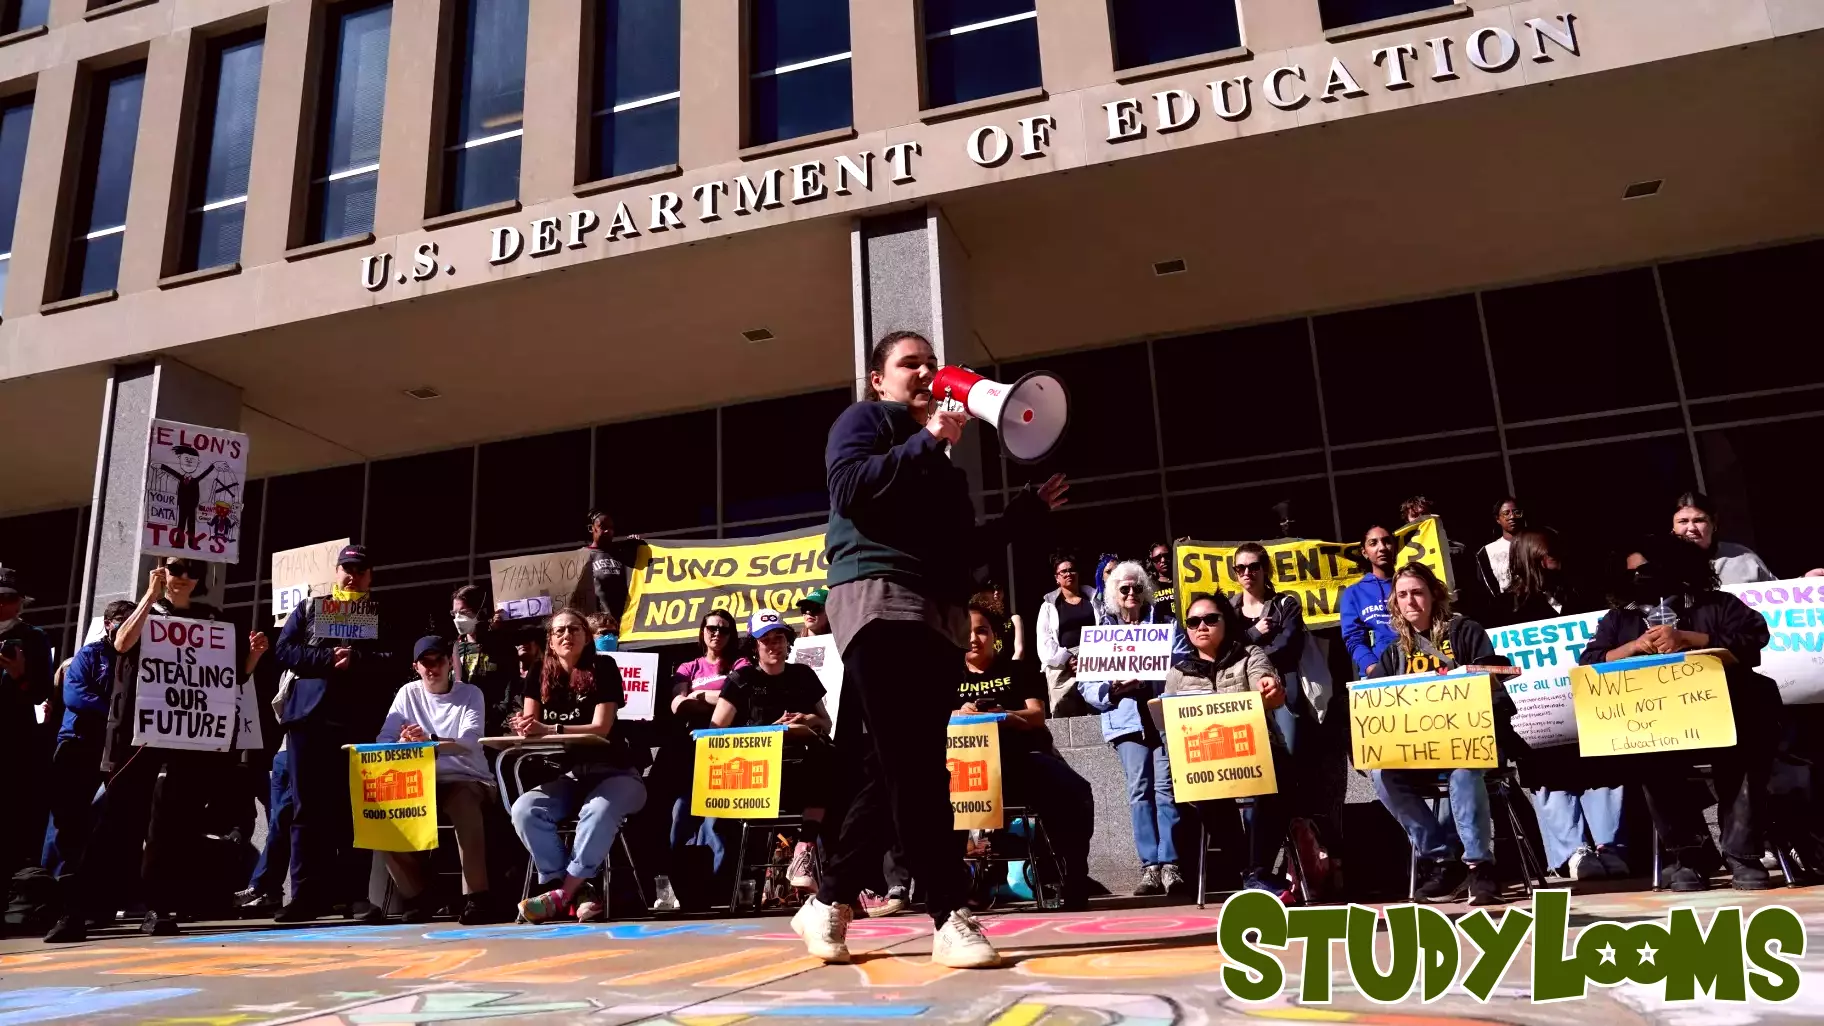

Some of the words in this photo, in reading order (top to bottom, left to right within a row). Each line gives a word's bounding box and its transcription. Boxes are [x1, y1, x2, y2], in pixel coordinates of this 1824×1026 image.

[360, 241, 456, 292] U.S.
[489, 141, 922, 266] DEPARTMENT
[966, 114, 1056, 168] OF
[1103, 13, 1580, 144] EDUCATION
[157, 426, 241, 459] ELON'S
[150, 491, 175, 505] YOUR
[151, 506, 175, 520] DATA
[147, 522, 226, 553] TOYS
[645, 554, 738, 584] FUND
[1182, 544, 1365, 583] STENTS
[498, 560, 552, 592] THANK
[280, 588, 302, 611] ED
[507, 598, 542, 619] ED
[644, 596, 705, 626] NOT
[150, 619, 225, 649] DOGE
[329, 624, 365, 638] FUTURE
[1083, 628, 1169, 643] EDUCATION
[176, 647, 197, 665] IS
[1113, 643, 1123, 652] is
[1078, 655, 1127, 673] HUMAN
[1128, 655, 1170, 673] RIGHT
[1506, 646, 1557, 669] ITH
[141, 657, 234, 688] STEALING
[957, 676, 1011, 692] UNRISE
[1426, 683, 1470, 702] CAN
[1533, 679, 1550, 690] all
[1585, 670, 1643, 696] WWE
[165, 687, 208, 711] OUR
[1178, 704, 1203, 718] KIDS
[1206, 699, 1253, 715] DESERVE
[1635, 696, 1667, 712] NOT
[1678, 689, 1717, 705] TAKE
[139, 709, 227, 738] FUTURE
[1355, 714, 1396, 738] YOU
[1404, 713, 1459, 733] LOOK
[1468, 711, 1492, 728] US
[708, 737, 730, 748] KIDS
[733, 736, 772, 748] DESERVE
[947, 735, 989, 749] DESERVE
[1361, 744, 1382, 764] IN
[1396, 741, 1441, 762] THE
[1451, 735, 1494, 761] EYES?
[1611, 733, 1679, 751] Education
[361, 751, 383, 764] KIDS
[385, 747, 424, 762] DESERVE
[1186, 770, 1214, 784] GOOD
[1217, 765, 1263, 781] SCHOOLS
[363, 808, 387, 819] GOOD
[389, 805, 427, 819] SCHOOLS
[705, 797, 730, 809] GOOD
[733, 797, 771, 809] SCHOOLS
[951, 800, 992, 813] SCHOOLS
